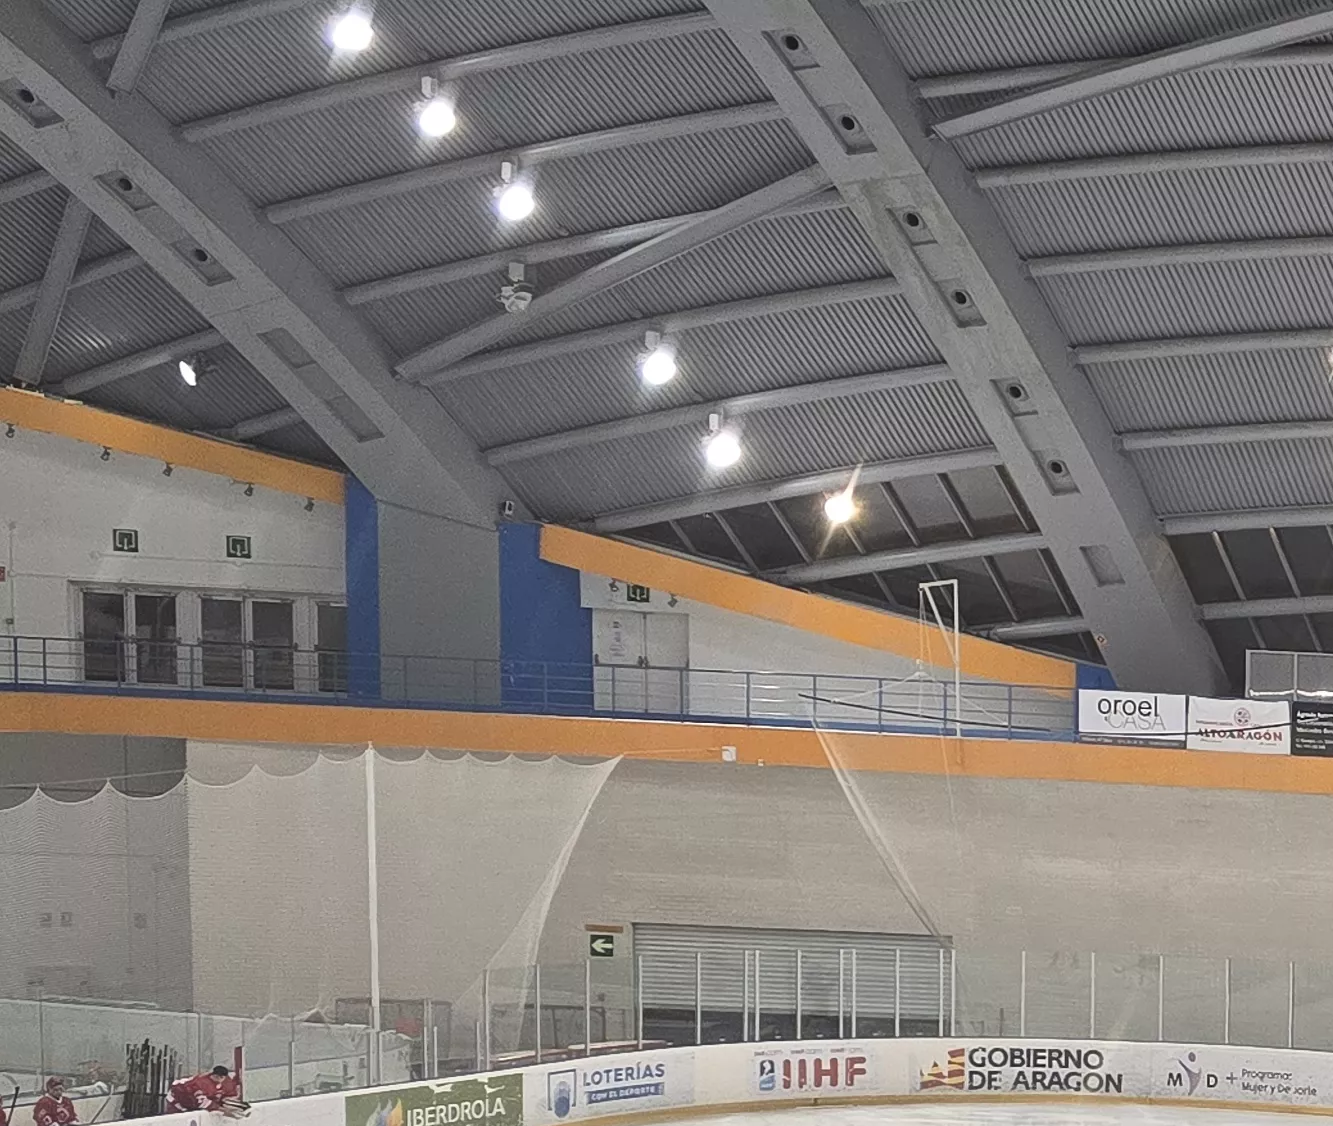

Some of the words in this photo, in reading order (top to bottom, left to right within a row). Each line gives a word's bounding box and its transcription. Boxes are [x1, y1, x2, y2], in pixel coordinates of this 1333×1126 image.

[1097, 695, 1158, 717] oroel
[968, 1046, 1105, 1070] GOBIERNO
[583, 1061, 666, 1087] LOTERÍAS
[782, 1056, 867, 1090] IIHF
[968, 1070, 1001, 1091] DE
[1010, 1070, 1124, 1093] ARAGON
